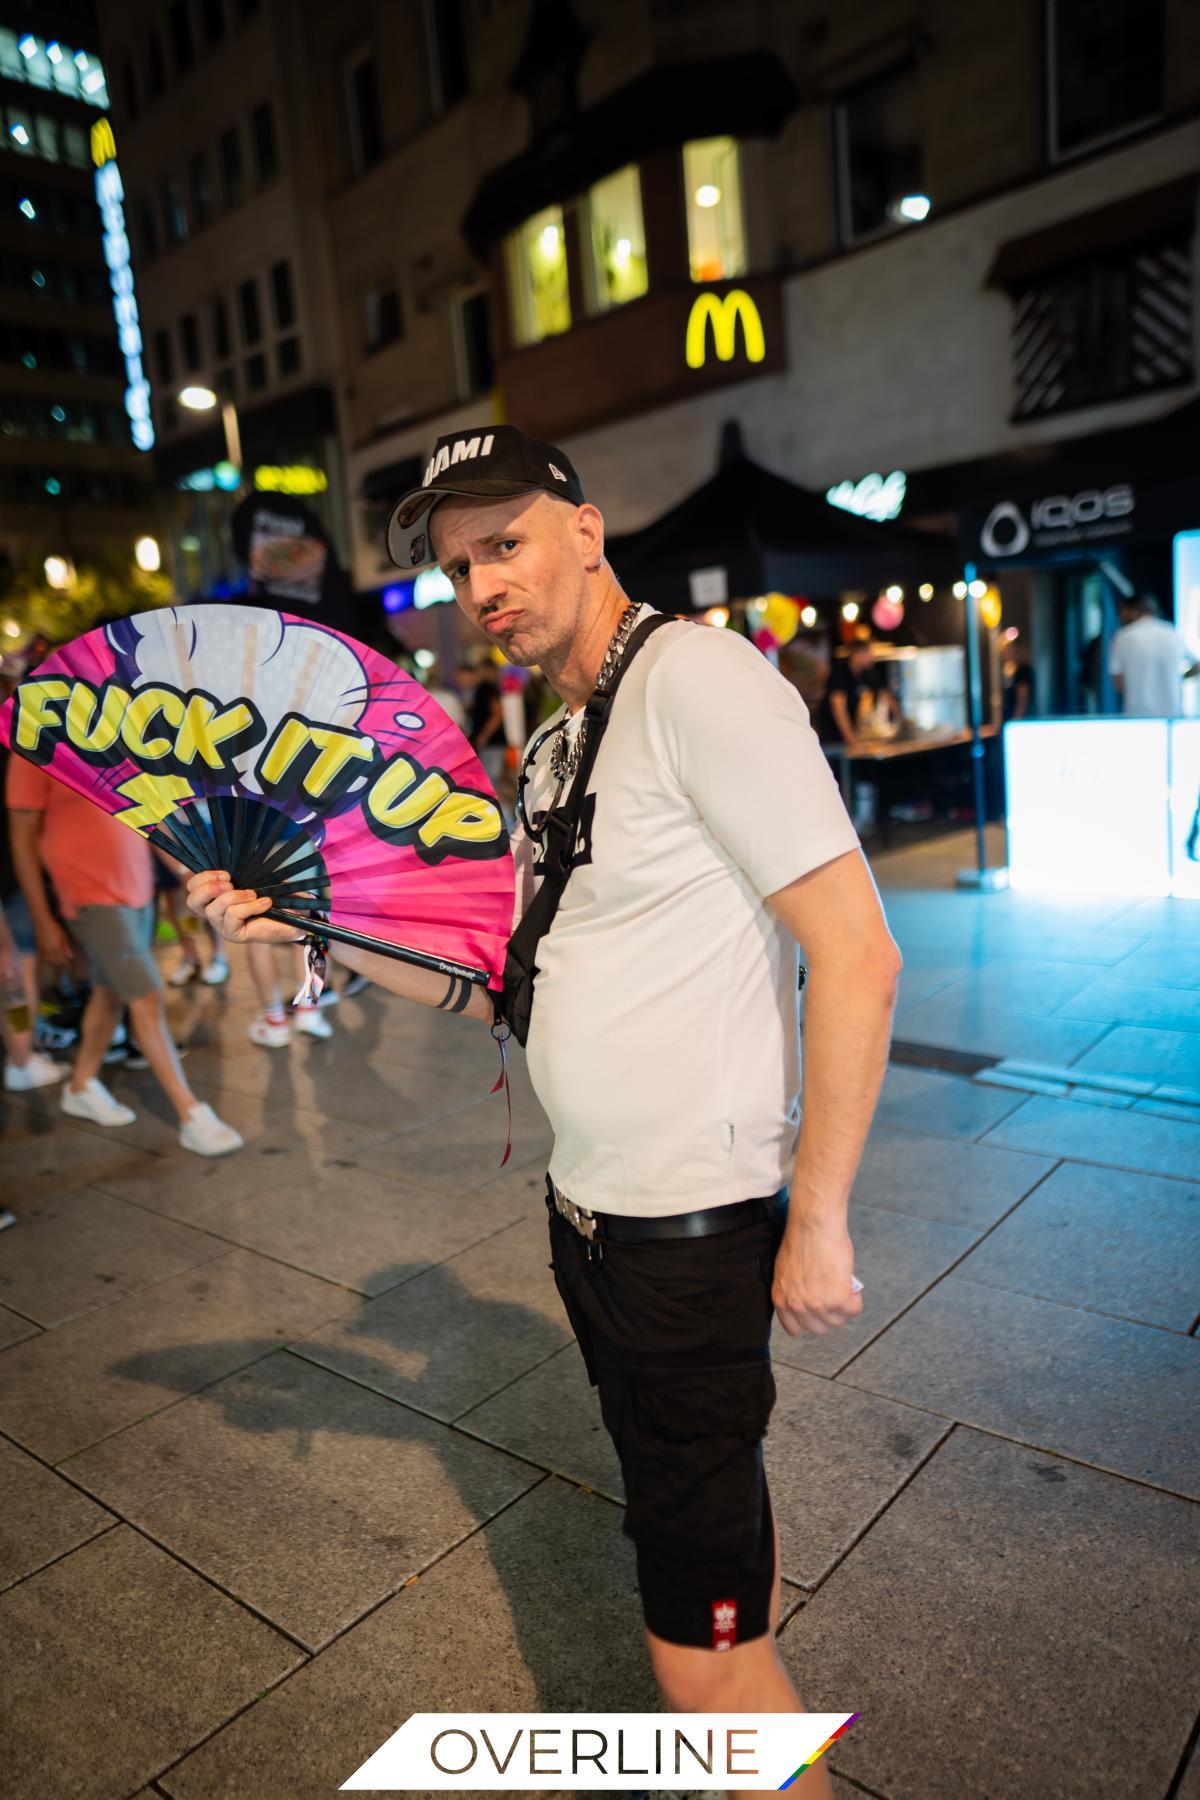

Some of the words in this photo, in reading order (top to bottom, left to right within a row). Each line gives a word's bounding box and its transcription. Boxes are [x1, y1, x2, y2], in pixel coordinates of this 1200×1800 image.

[1031, 483, 1135, 530] IQOS
[16, 680, 254, 770] FUCK
[260, 718, 374, 799] IT
[368, 757, 502, 848] UP
